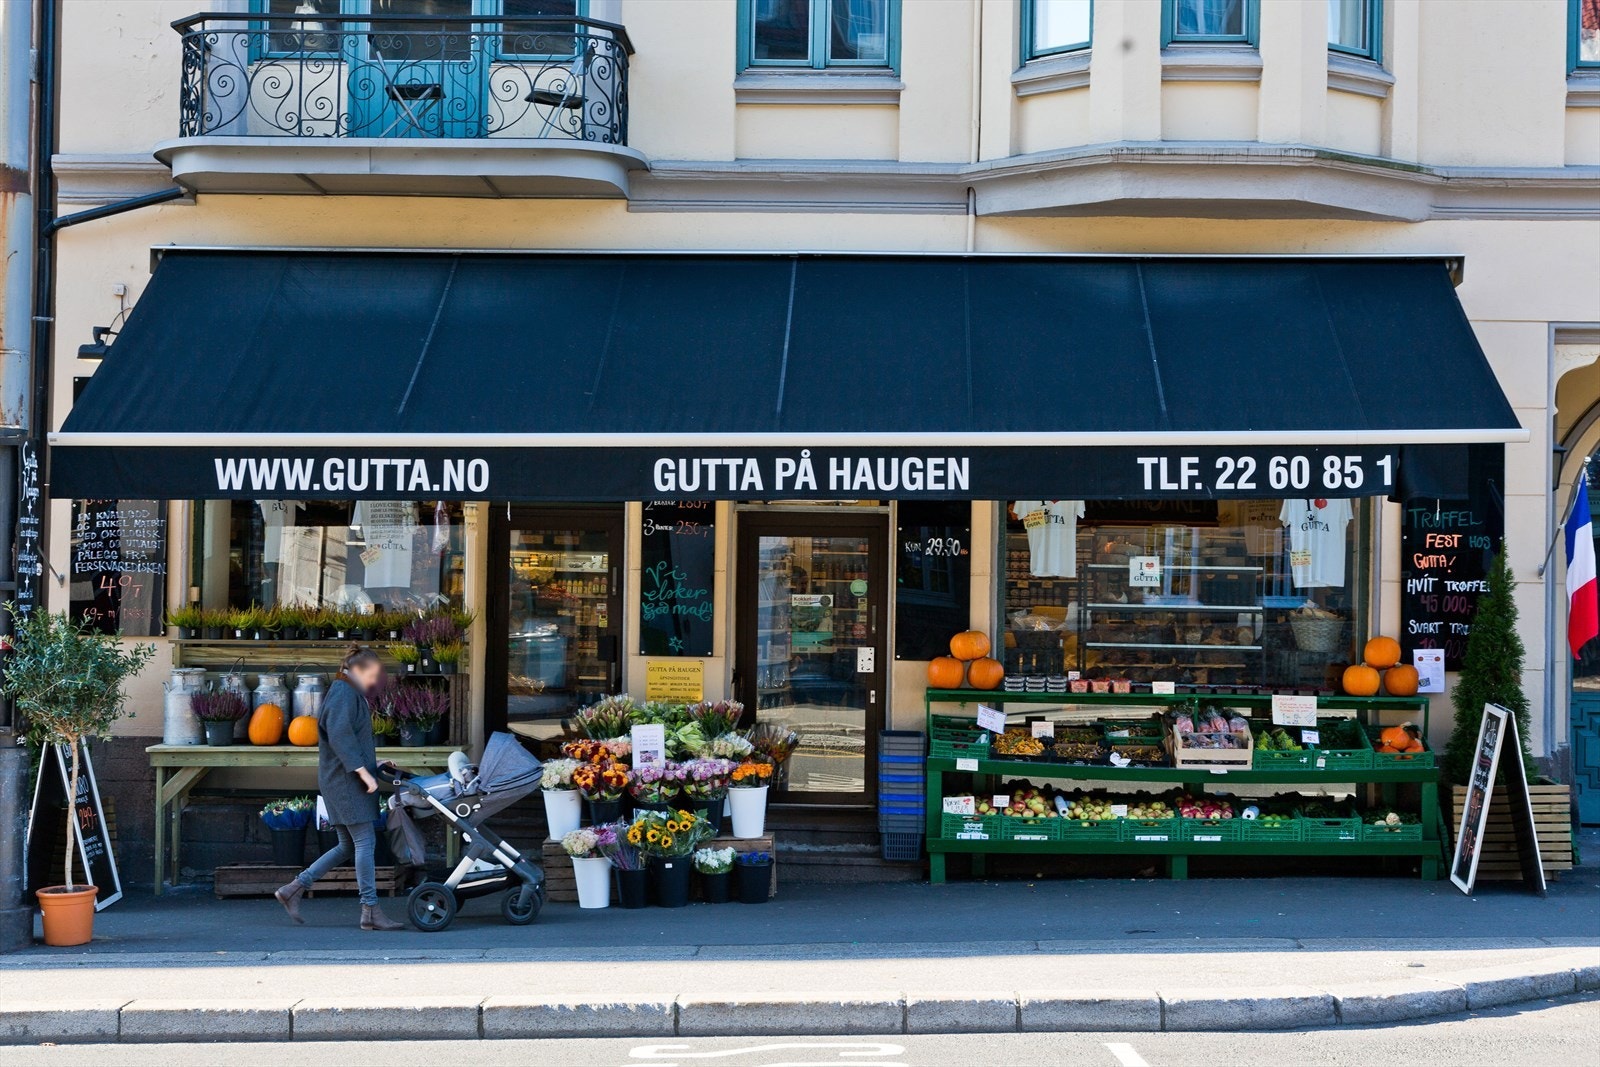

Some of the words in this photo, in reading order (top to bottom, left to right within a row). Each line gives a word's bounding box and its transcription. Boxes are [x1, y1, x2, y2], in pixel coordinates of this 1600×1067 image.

[215, 457, 490, 493] WWW.GUTTA.NO
[653, 457, 764, 492] GUTTA
[775, 448, 818, 491] PÅ
[829, 456, 970, 491] HAUGEN
[1136, 456, 1203, 490] TLF.
[1215, 456, 1257, 490] 22
[1268, 455, 1310, 490] 60
[1322, 455, 1364, 489] 85
[78, 512, 91, 522] EN
[77, 522, 91, 532] OG
[96, 519, 130, 528] ENKEL
[644, 518, 655, 536] 3
[905, 541, 922, 553] KUN
[1426, 533, 1463, 549] FEST
[1469, 536, 1491, 550] HOS
[77, 550, 119, 562] PÅLEGG
[125, 550, 148, 560] FRA
[1413, 553, 1456, 573] GUTTA!
[1139, 562, 1143, 570] I
[1444, 579, 1490, 593] TRØFFE
[1408, 619, 1443, 635] SVART
[669, 665, 676, 673] PÅ
